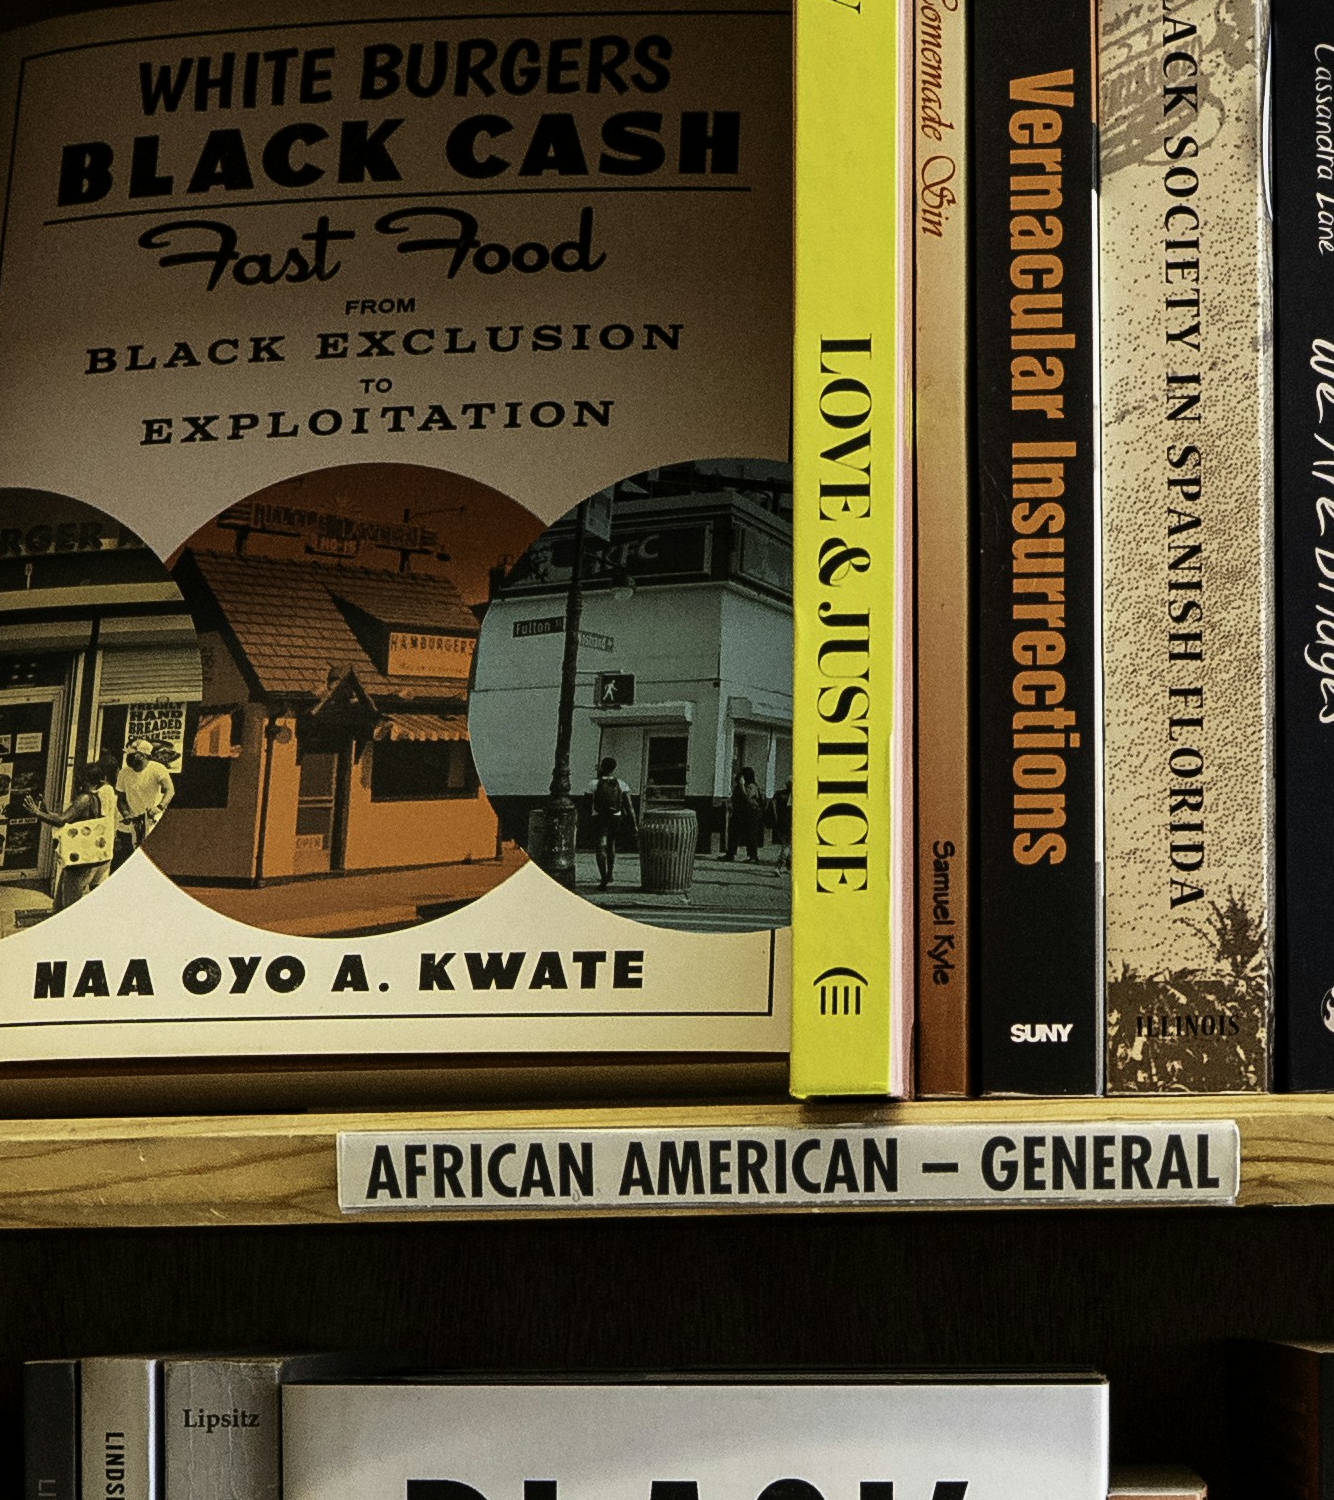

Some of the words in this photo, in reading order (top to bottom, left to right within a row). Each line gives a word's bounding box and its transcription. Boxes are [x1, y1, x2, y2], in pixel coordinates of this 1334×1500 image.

[57, 119, 404, 207] BLACK
[446, 110, 741, 178] CASH
[820, 339, 871, 520] LOVE
[819, 538, 870, 585] &
[817, 614, 869, 892] JUSTICE
[1011, 1024, 1073, 1043] SUNY
[367, 1143, 593, 1199] AFRICAN
[619, 1138, 897, 1195] AMERICAN
[981, 1135, 1219, 1191] GENERAL
